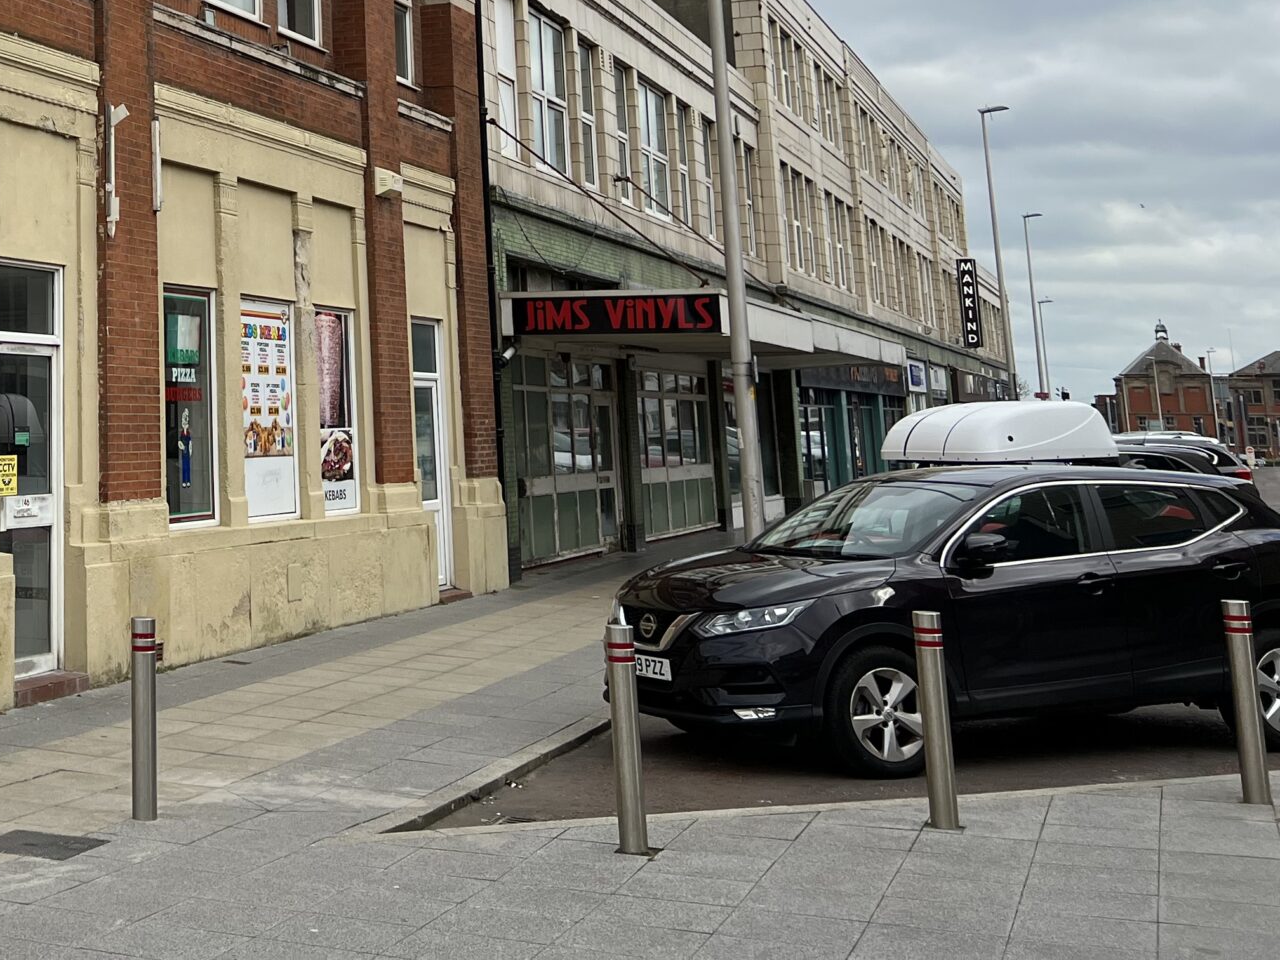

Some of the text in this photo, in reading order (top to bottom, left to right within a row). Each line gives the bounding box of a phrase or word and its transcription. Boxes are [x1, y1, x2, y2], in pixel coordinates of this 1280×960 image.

[960, 262, 978, 343] MANKIND
[172, 368, 196, 382] PIZZA
[325, 489, 347, 501] KEBABS
[636, 657, 665, 676] 9 PZZ
